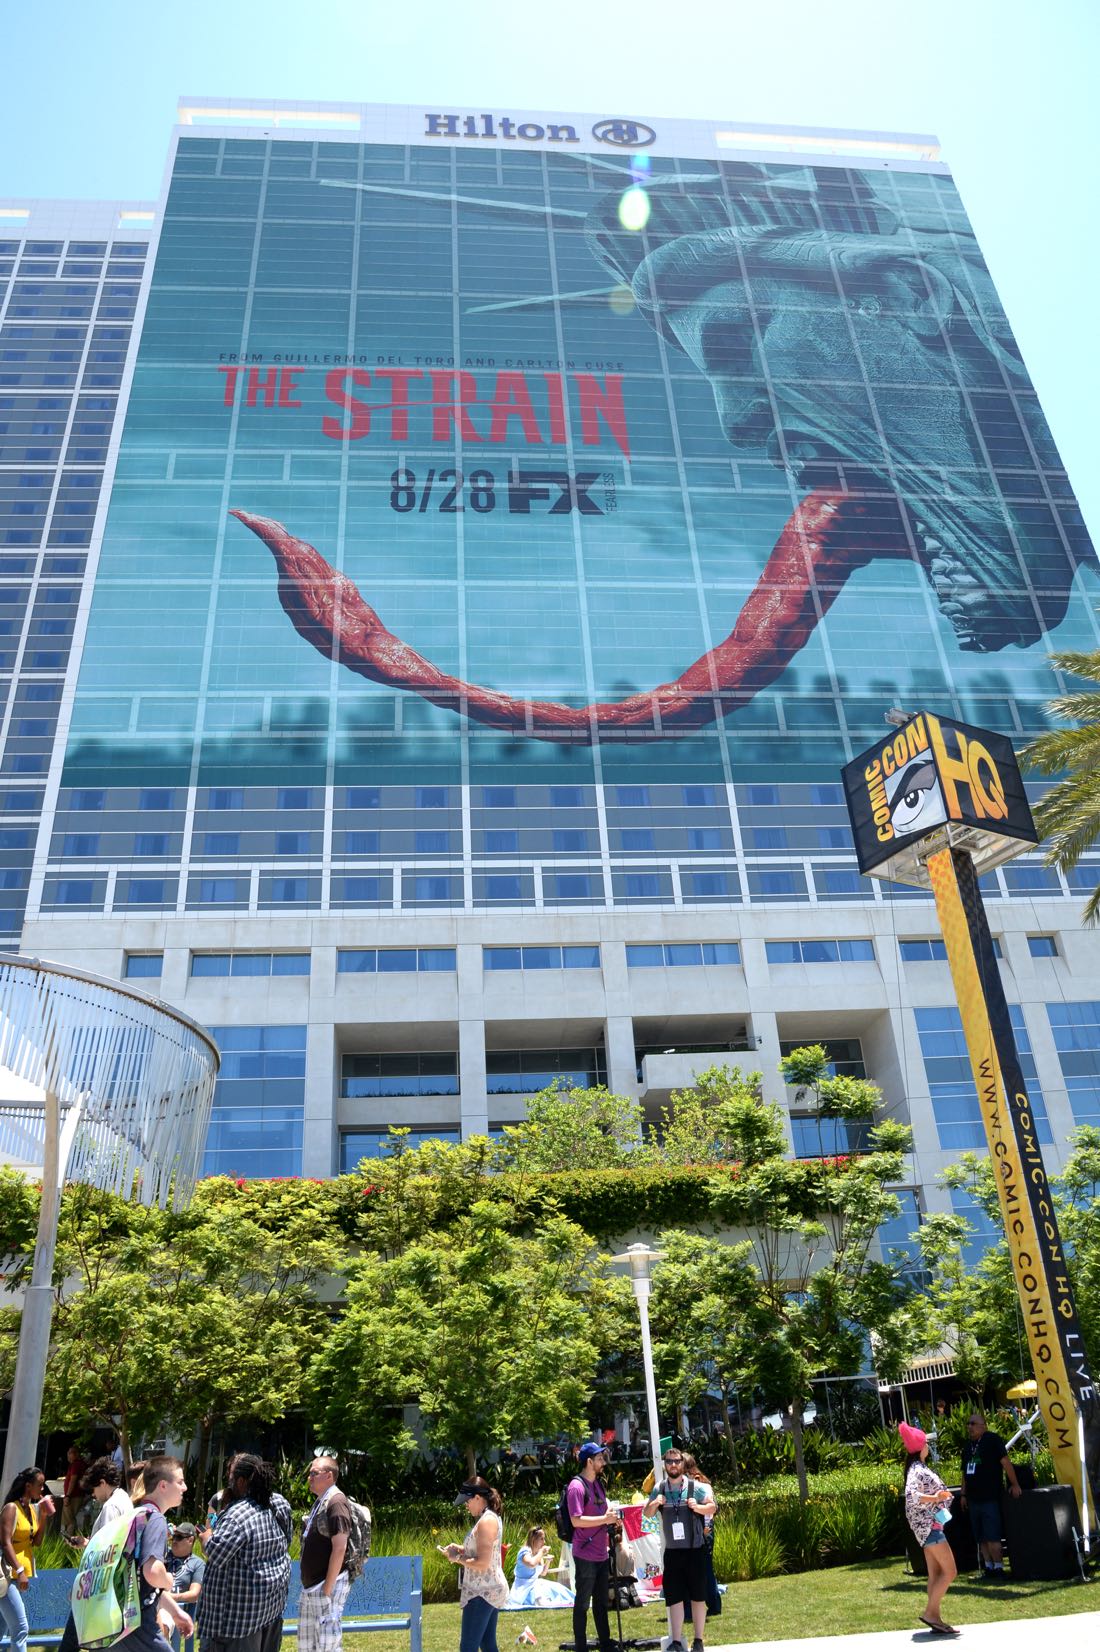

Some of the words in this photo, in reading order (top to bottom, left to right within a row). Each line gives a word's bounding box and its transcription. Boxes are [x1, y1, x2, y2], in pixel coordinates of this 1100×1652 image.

[425, 114, 580, 142] Hilton
[219, 353, 263, 362] FROM
[273, 354, 368, 364] GUILLERMO
[377, 355, 404, 365] DEL
[414, 356, 455, 366] TORO
[465, 357, 496, 367] AND
[504, 359, 576, 369] CARLTON
[585, 361, 625, 371] CUSE
[218, 365, 305, 408] THE
[322, 367, 631, 465] STRAIN
[390, 468, 496, 514] 8/28
[508, 471, 606, 516] FX
[602, 472, 617, 512] FEARLESS
[865, 759, 894, 842] COMIC
[881, 715, 930, 777] CON
[925, 712, 1009, 820] HQ
[979, 1058, 1073, 1449] WWW.COMIC-CONHQ.COM
[1015, 1092, 1062, 1262] COMIC-CON
[1055, 1276, 1074, 1318] HQ
[1065, 1333, 1091, 1401] LIVE
[76, 1566, 112, 1600] SQUAD
